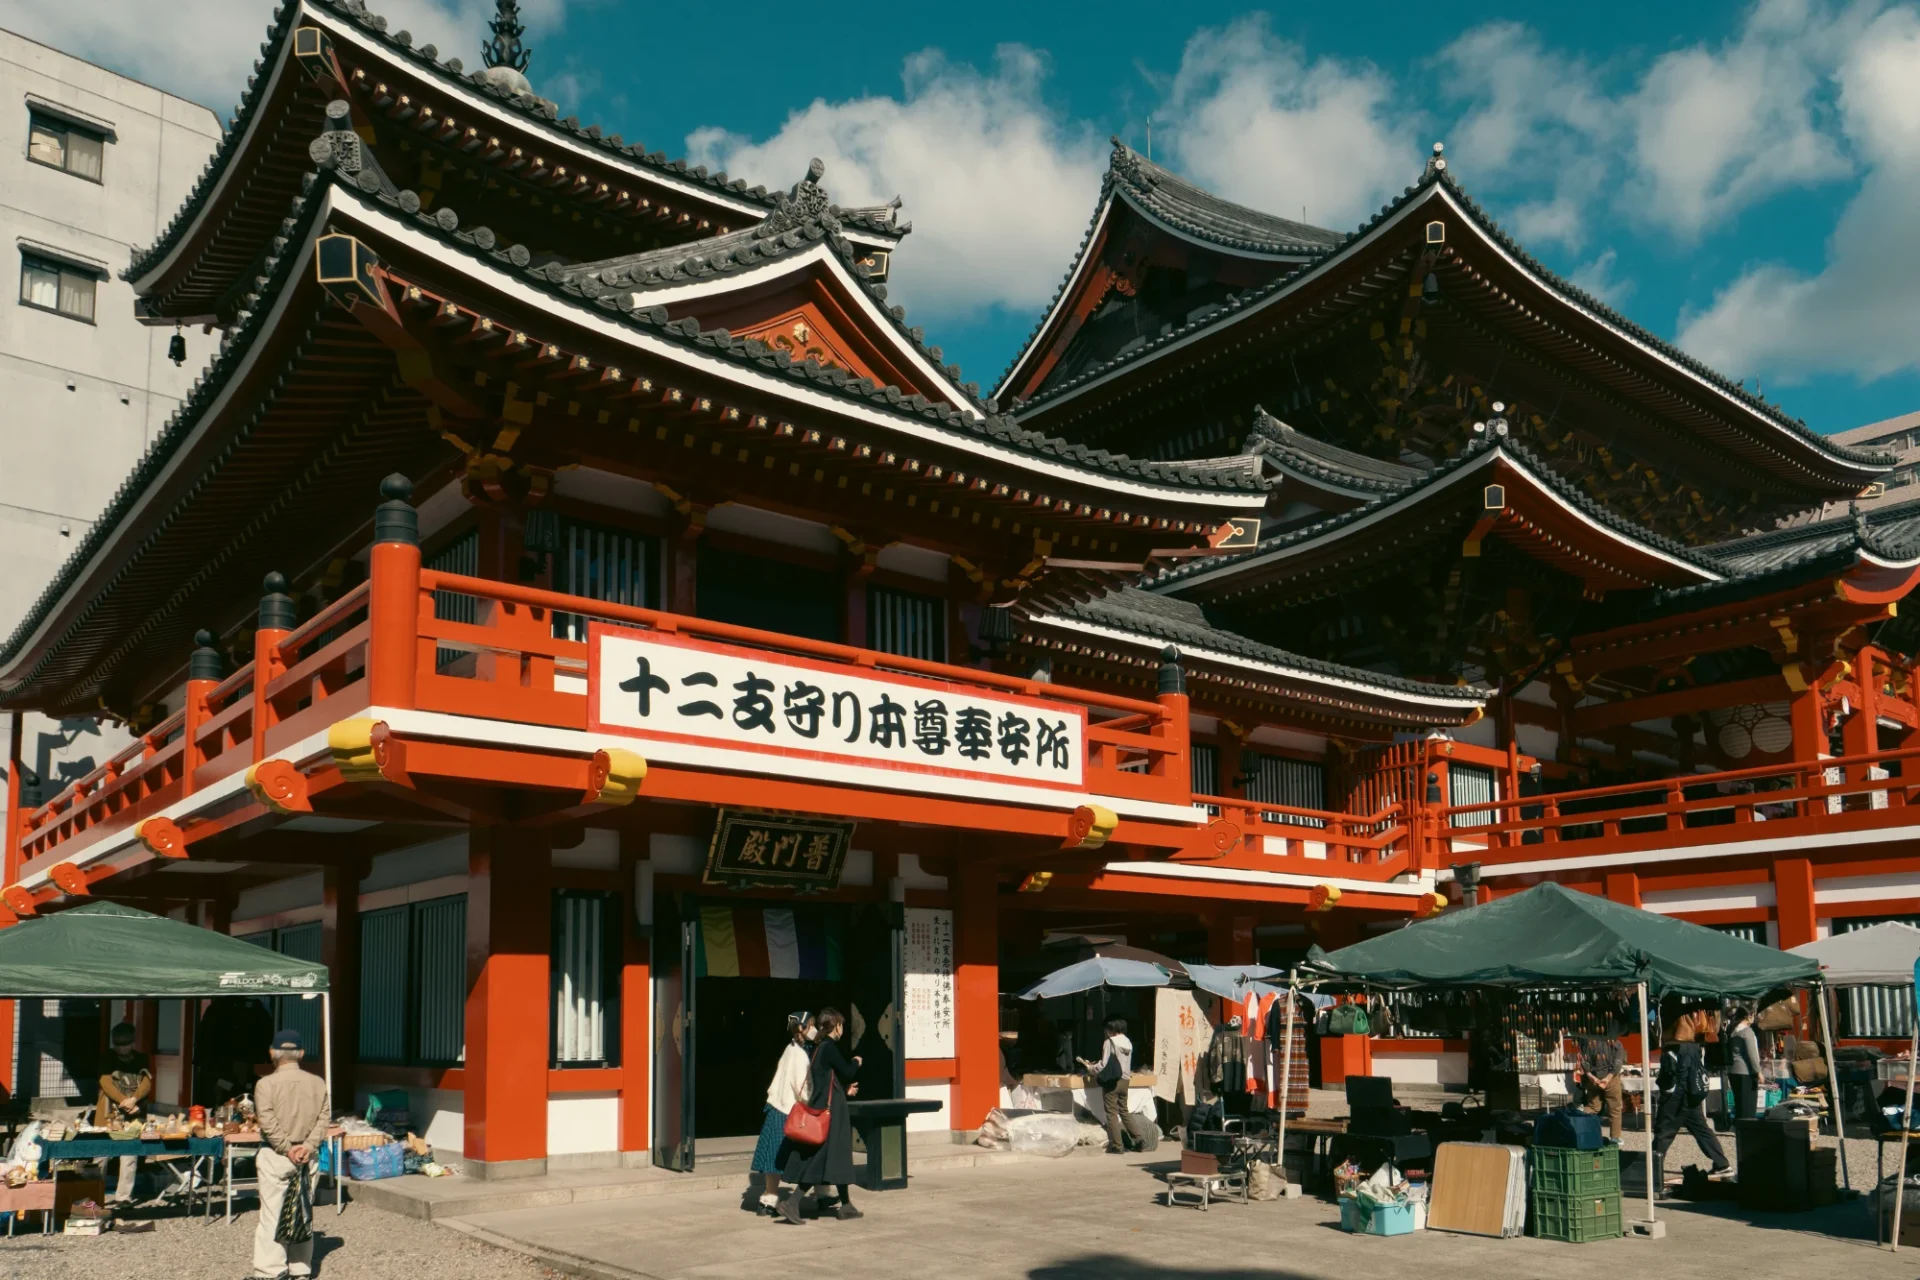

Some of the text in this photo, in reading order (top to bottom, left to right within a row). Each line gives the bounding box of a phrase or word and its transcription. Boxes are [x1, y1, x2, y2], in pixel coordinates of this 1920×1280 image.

[619, 656, 1069, 770] 十二支守り本尊奉安所
